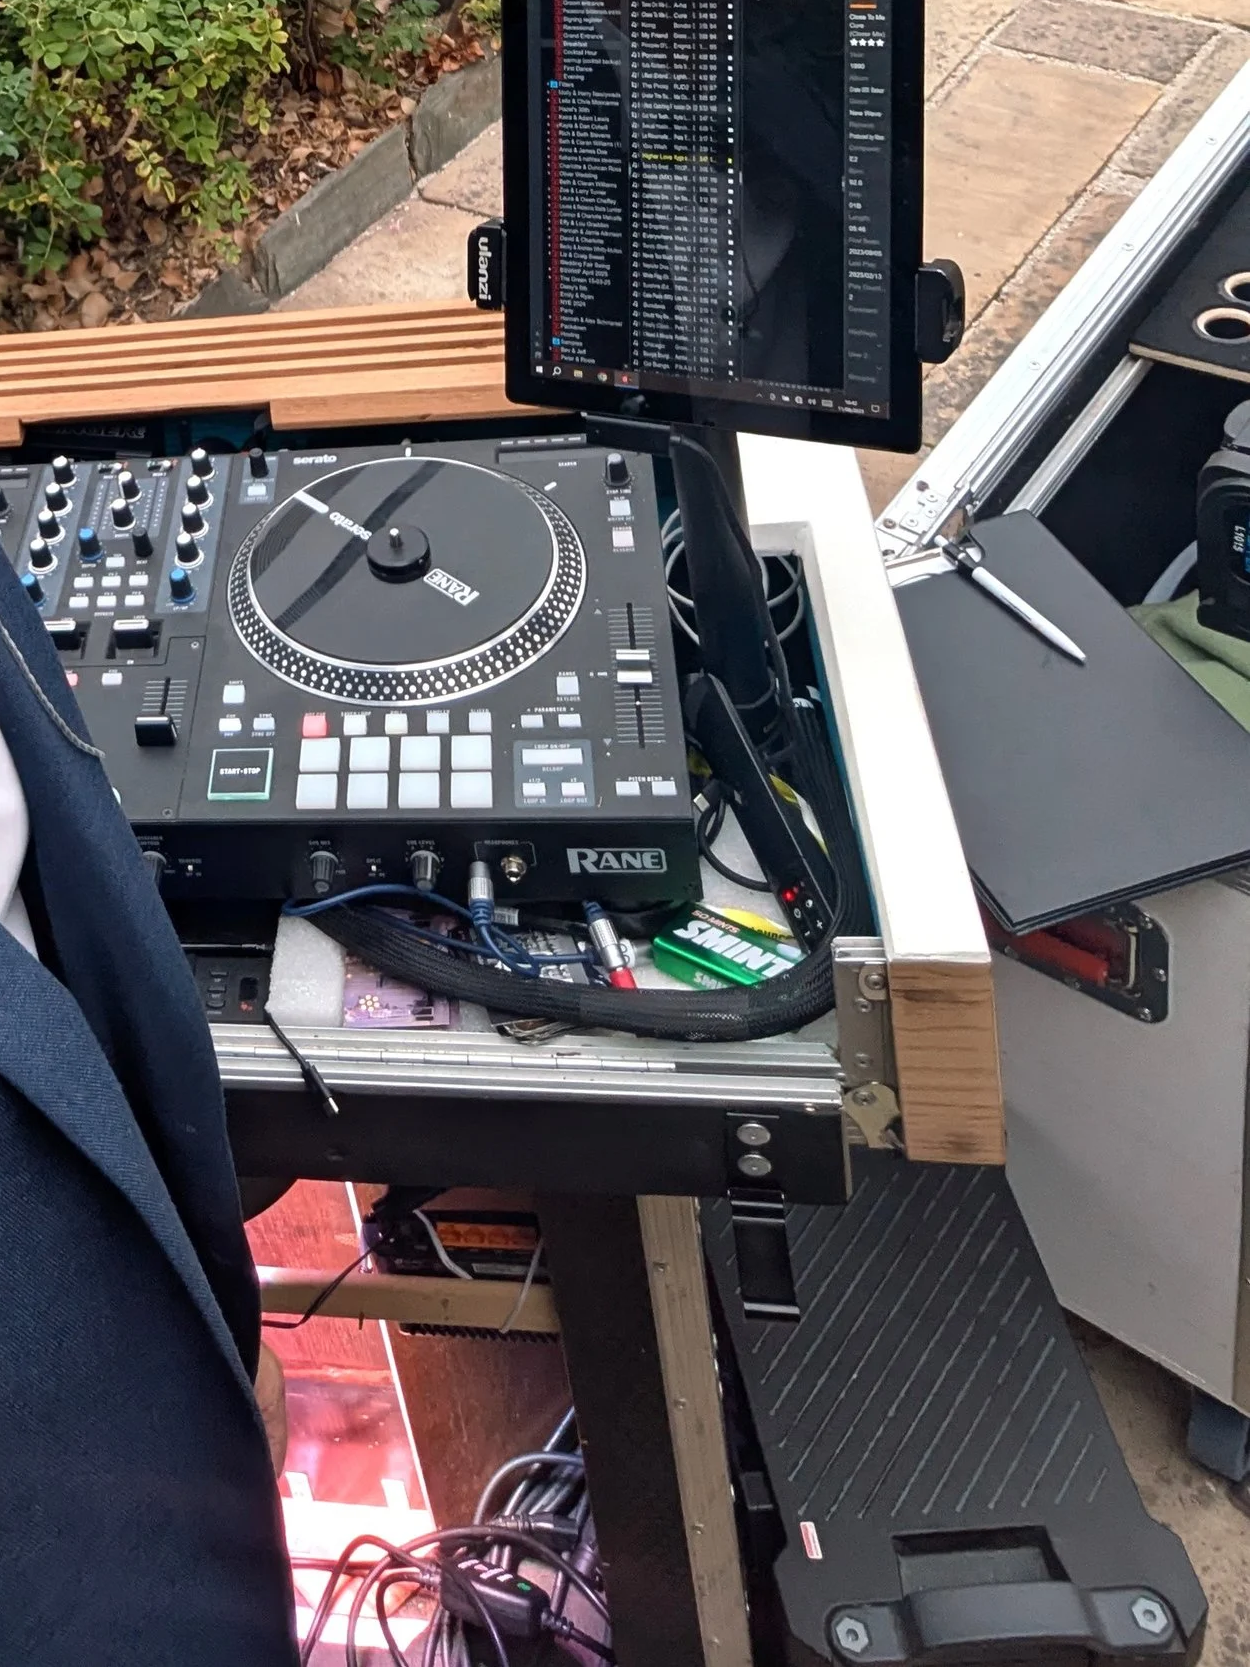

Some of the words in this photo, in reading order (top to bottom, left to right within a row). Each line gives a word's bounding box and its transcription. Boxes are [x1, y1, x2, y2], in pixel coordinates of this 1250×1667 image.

[478, 236, 492, 301] ulanzi
[293, 453, 337, 466] serato
[329, 511, 373, 541] serato
[427, 568, 480, 607] RANE
[566, 847, 666, 874] RANE
[708, 916, 740, 934] MINTS
[672, 920, 795, 978] SMINT
